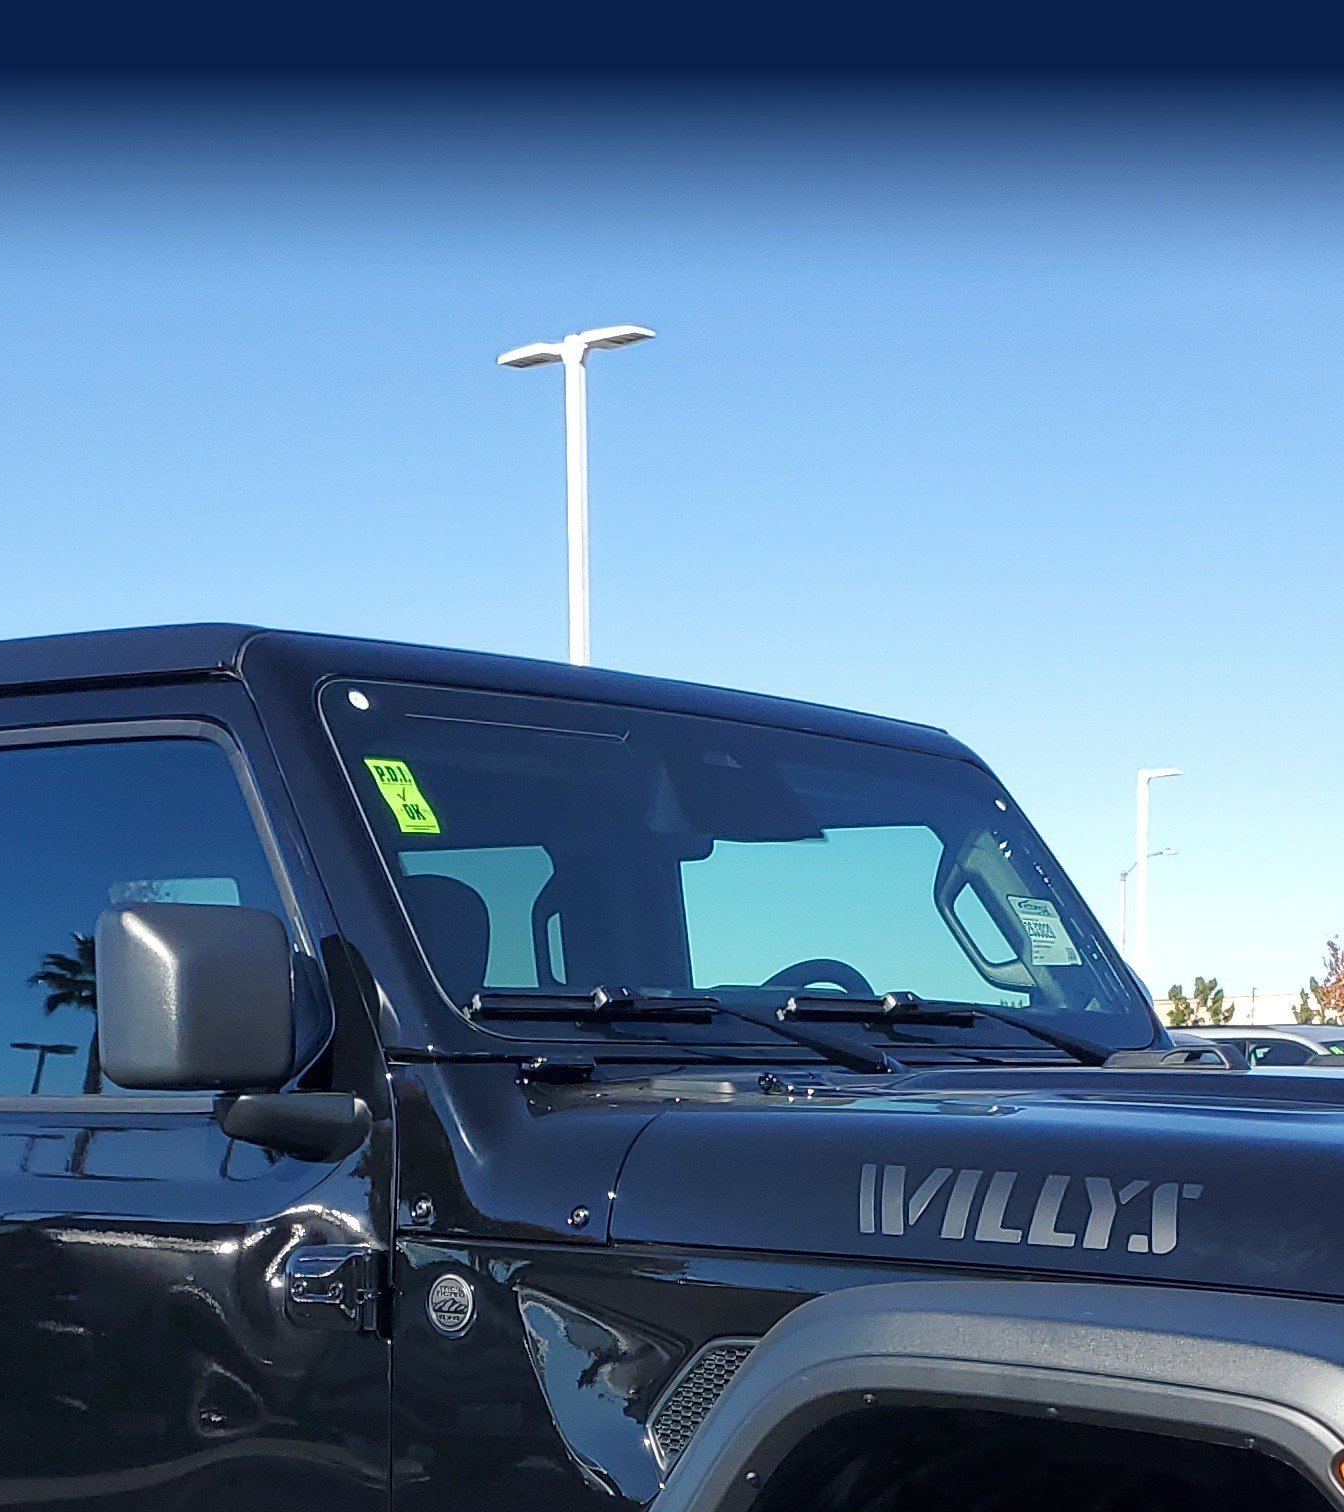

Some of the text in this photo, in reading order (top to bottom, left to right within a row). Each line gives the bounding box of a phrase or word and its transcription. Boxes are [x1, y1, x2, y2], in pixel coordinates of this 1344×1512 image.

[373, 765, 412, 784] P.D.I.
[403, 803, 426, 821] OK
[859, 1163, 1204, 1255] WILLYS
